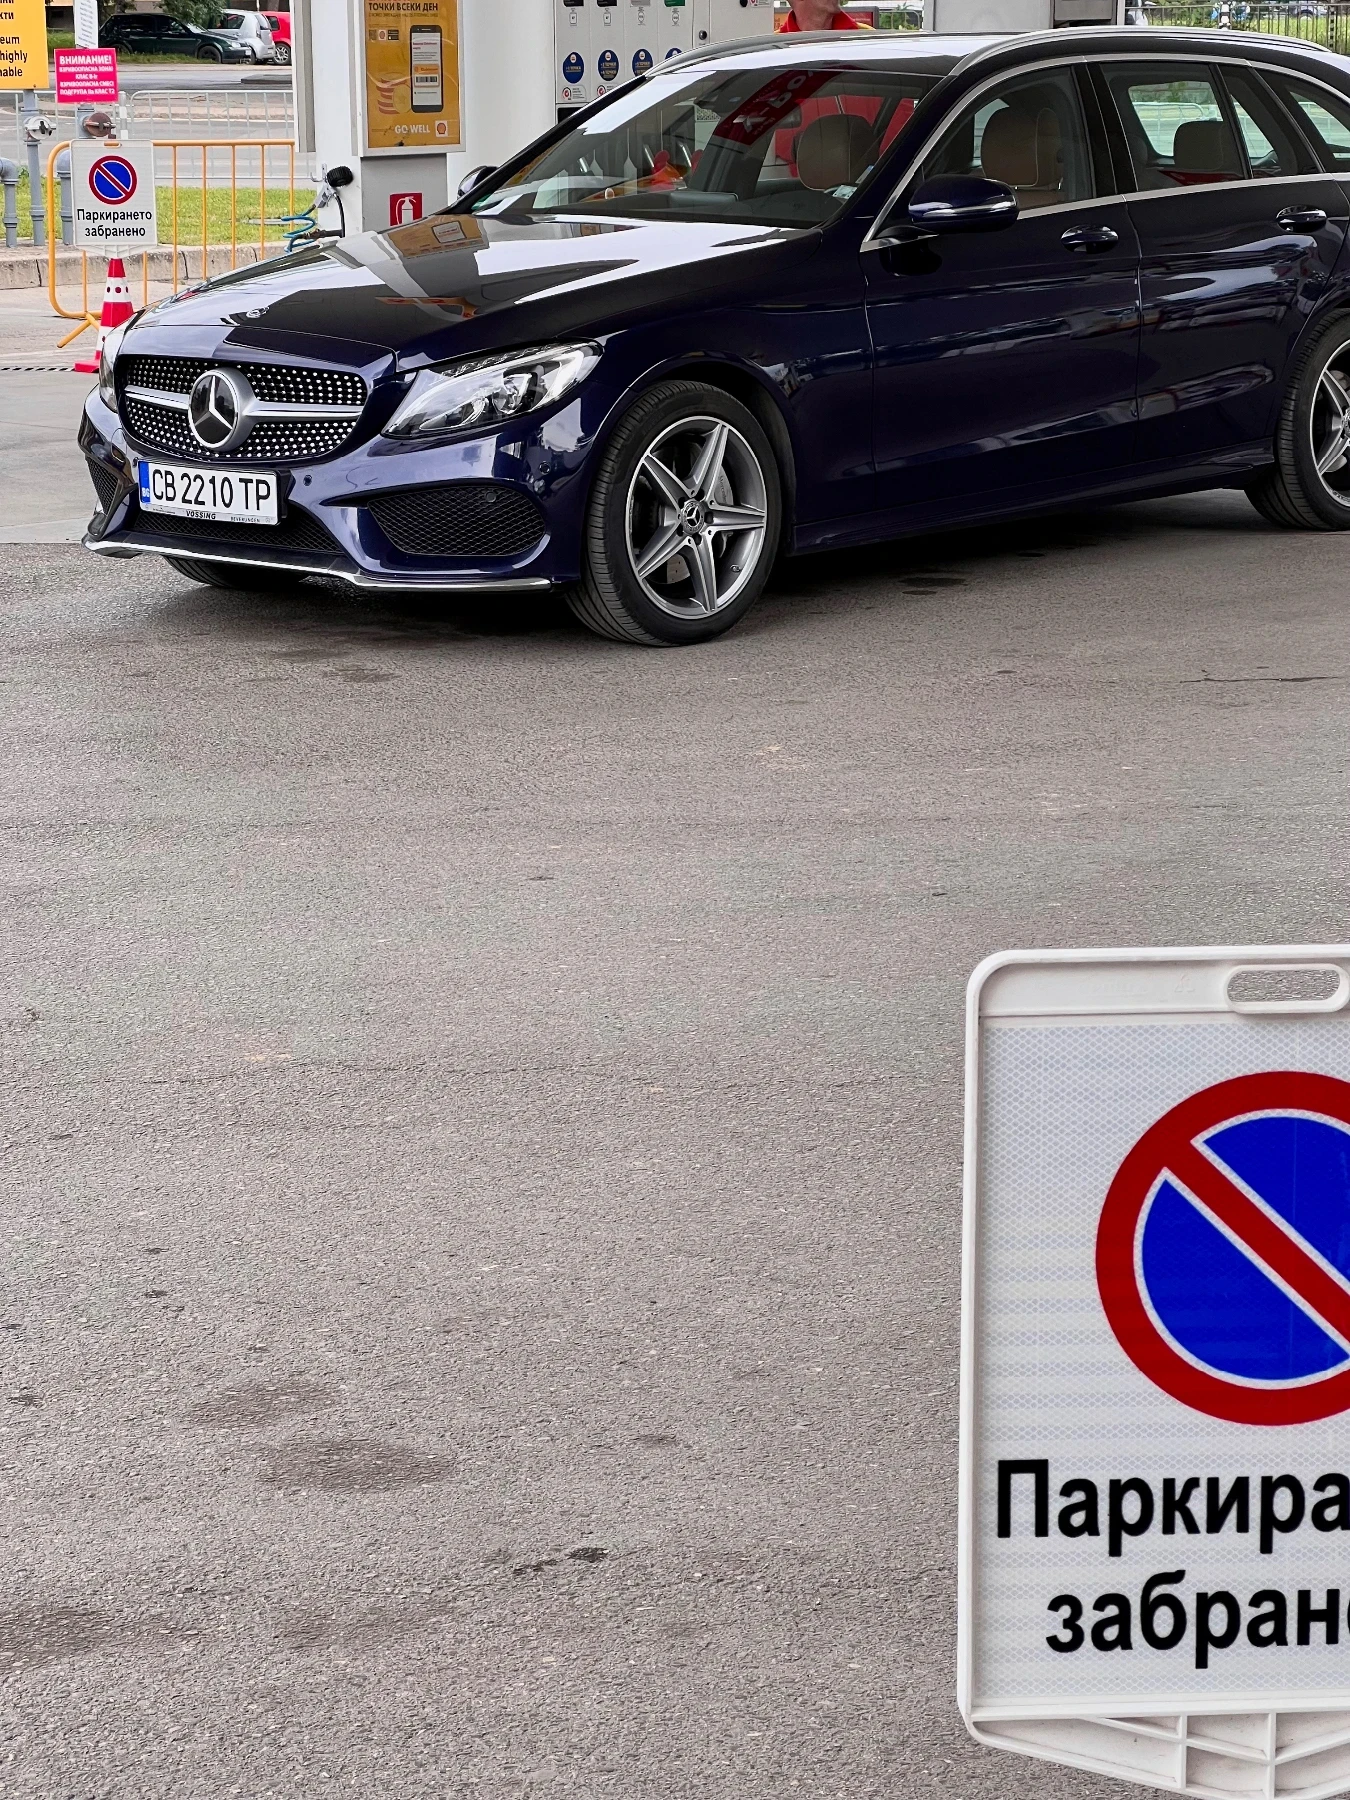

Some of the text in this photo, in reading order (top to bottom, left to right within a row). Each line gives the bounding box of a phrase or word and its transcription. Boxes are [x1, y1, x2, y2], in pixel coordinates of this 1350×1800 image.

[369, 3, 438, 12] ТОЧКИ ВСЕКИ ДЕН
[60, 55, 112, 65] ВНИМАНИЕ!
[394, 124, 408, 134] GO
[410, 124, 430, 133] WELL
[77, 208, 152, 223] Паркирането
[84, 224, 146, 239] забранено
[142, 488, 150, 498] BG
[181, 472, 233, 508] 2210
[997, 1458, 1350, 1557] Паркира
[1045, 1569, 1350, 1669] забран
